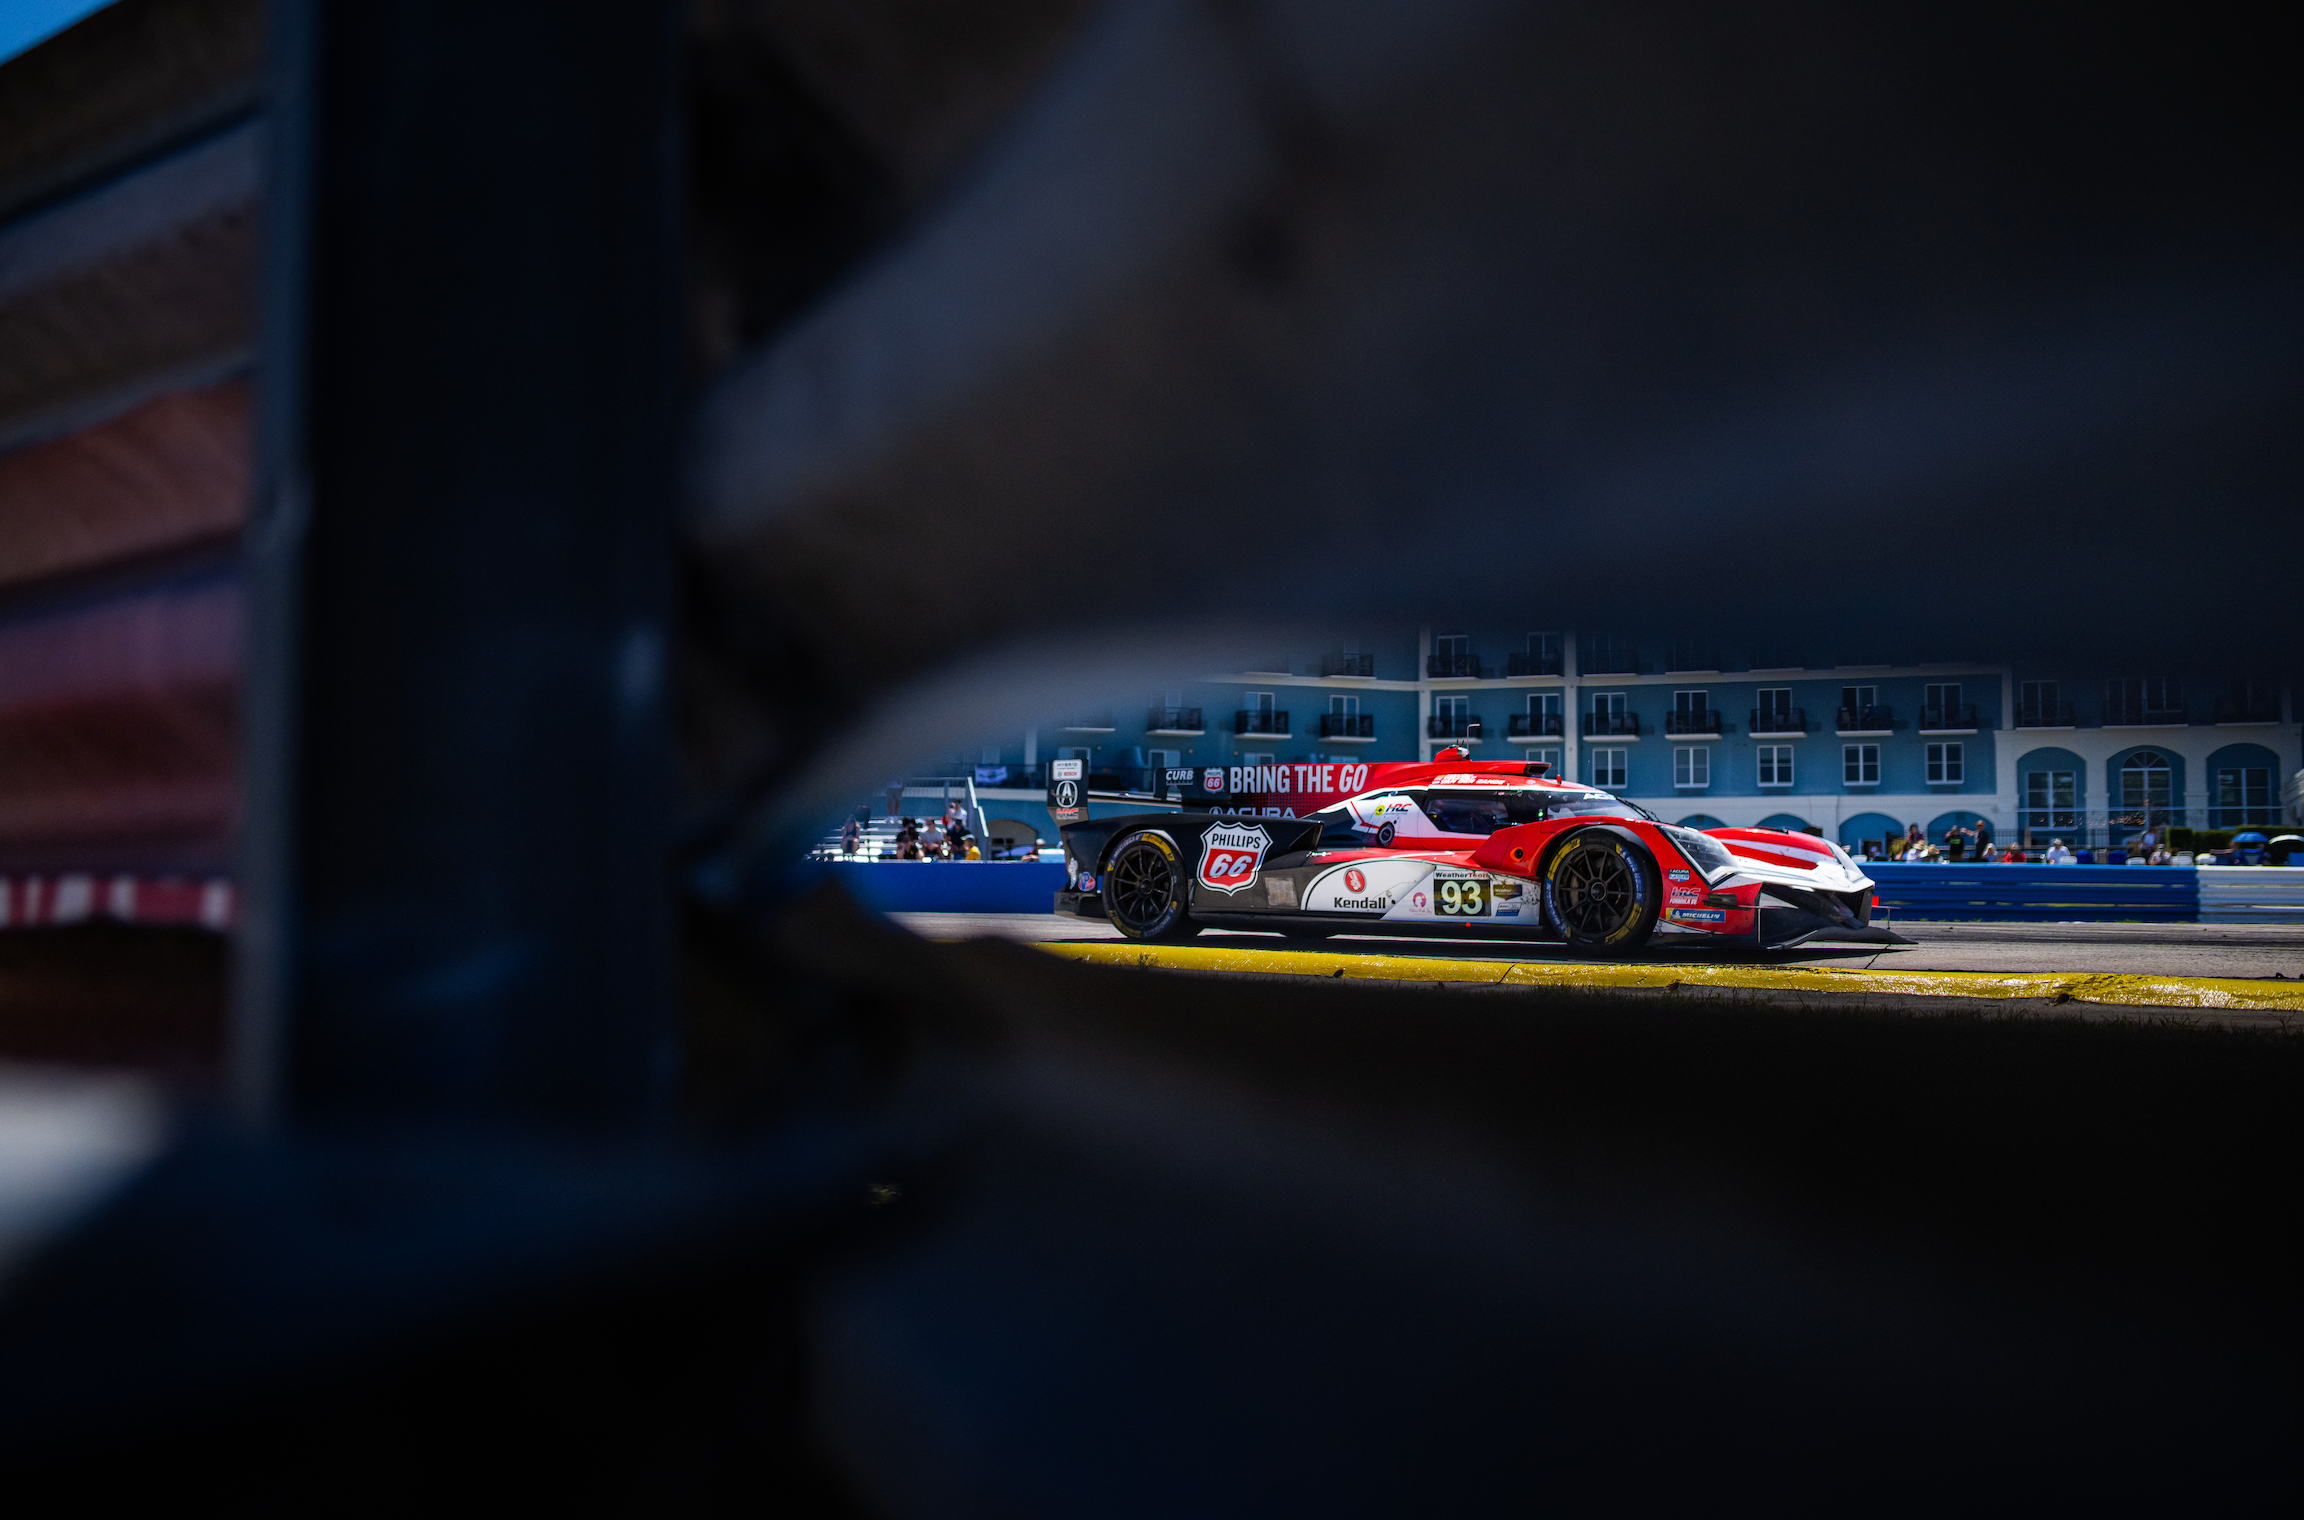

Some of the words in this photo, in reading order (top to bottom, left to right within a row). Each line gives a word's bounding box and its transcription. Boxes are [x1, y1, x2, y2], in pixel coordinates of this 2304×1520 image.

[1165, 770, 1194, 780] CURB
[1207, 777, 1220, 788] 66
[1230, 766, 1290, 793] BRING
[1295, 765, 1334, 793] THE
[1339, 764, 1368, 793] GO
[1211, 833, 1261, 849] PHILLIPS
[1209, 853, 1253, 878] 66
[1334, 897, 1386, 909] Kendall
[1441, 880, 1483, 914] 93
